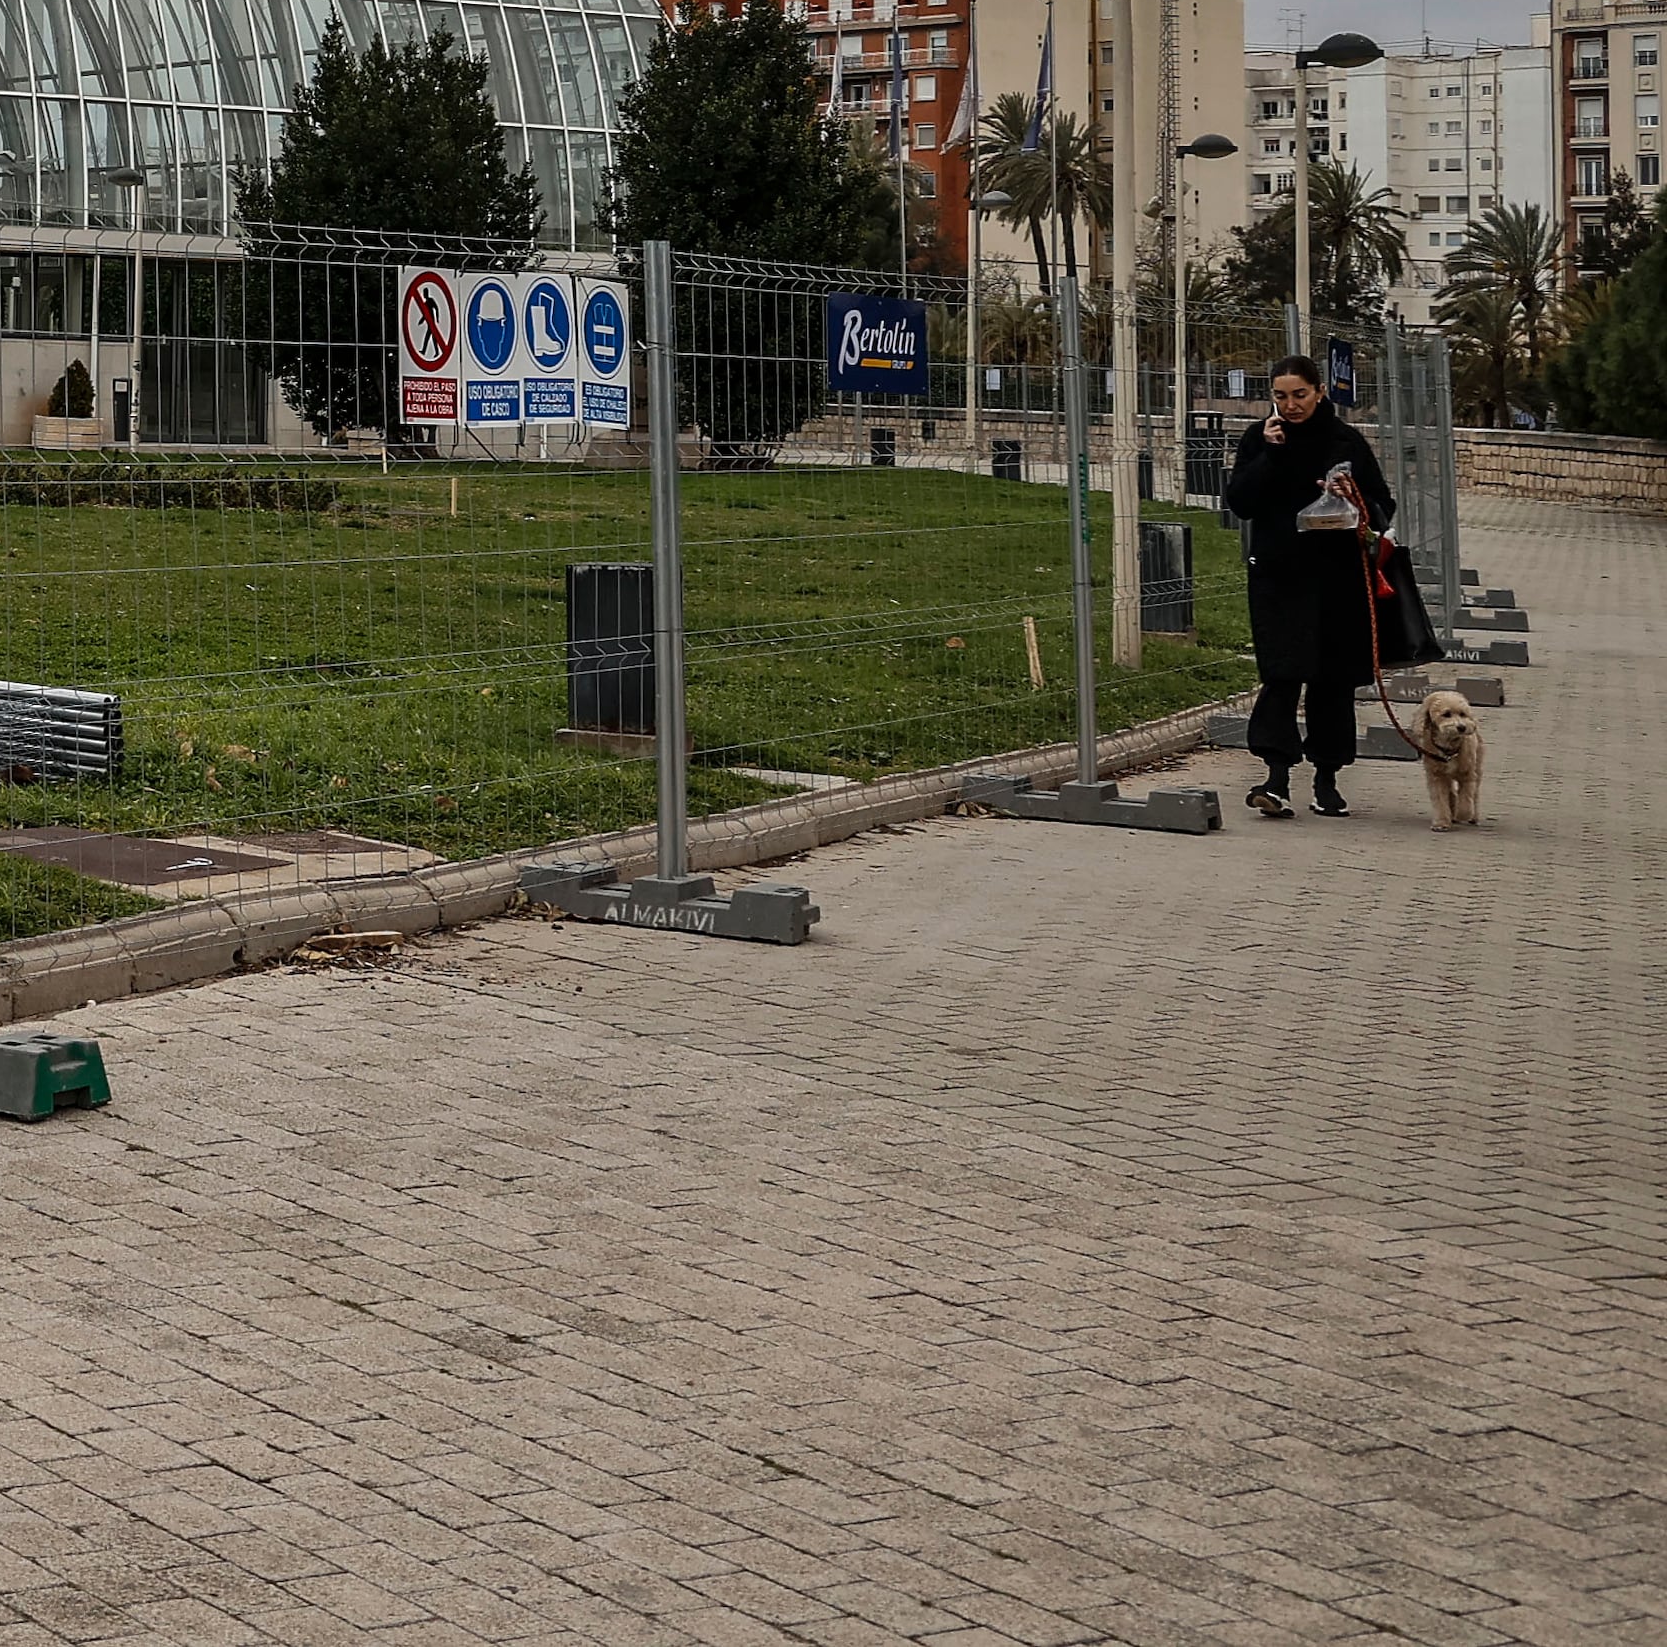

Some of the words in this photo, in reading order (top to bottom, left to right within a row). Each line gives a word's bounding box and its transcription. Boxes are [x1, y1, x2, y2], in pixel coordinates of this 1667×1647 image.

[838, 309, 916, 375] Bertolín
[441, 382, 456, 392] PASO
[468, 385, 482, 400] USO
[483, 385, 519, 400] OBLIGATORIO
[428, 393, 453, 403] PERSONA
[532, 393, 540, 403] DE
[541, 393, 567, 403] CALZADO
[481, 402, 490, 416] DE
[491, 402, 510, 416] CASCO
[529, 404, 538, 413] DE
[538, 404, 571, 414] SEGURIDAD
[1444, 648, 1480, 662] AKIVI
